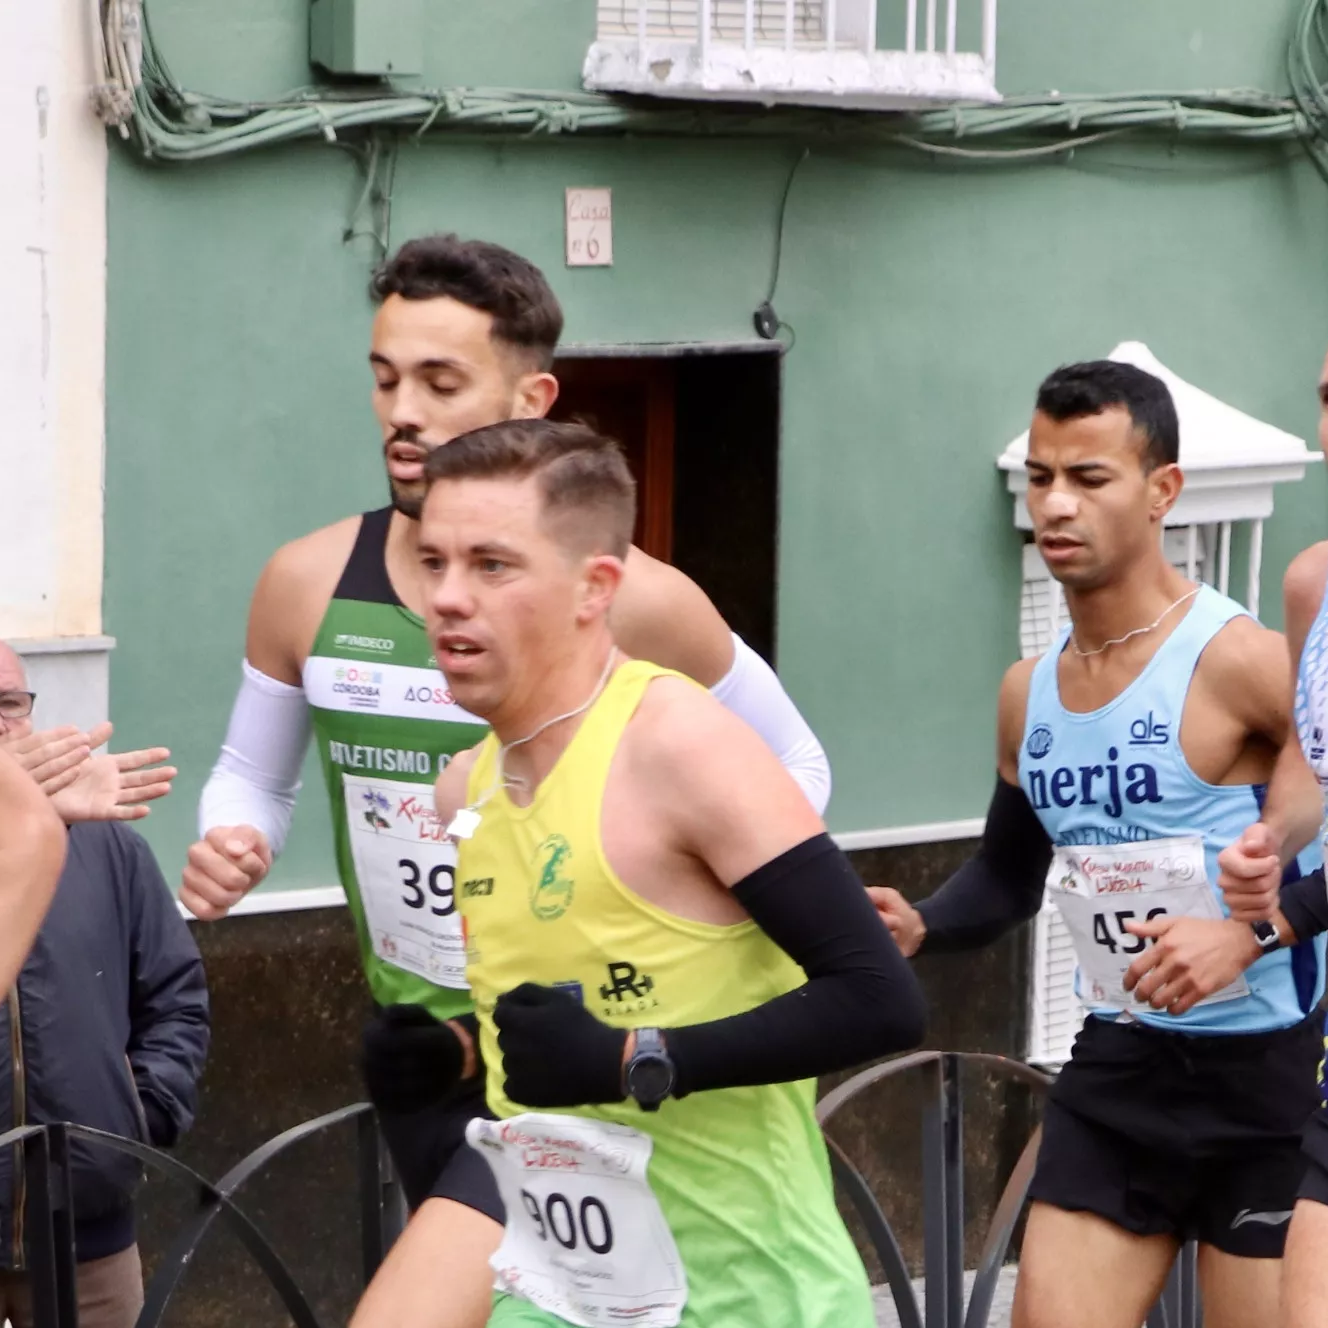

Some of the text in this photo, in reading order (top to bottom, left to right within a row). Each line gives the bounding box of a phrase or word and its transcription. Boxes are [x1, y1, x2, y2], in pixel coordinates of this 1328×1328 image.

[586, 224, 601, 260] 6
[329, 739, 431, 775] ATLETISMO
[1028, 745, 1164, 819] nerja
[520, 1187, 614, 1255] 900
